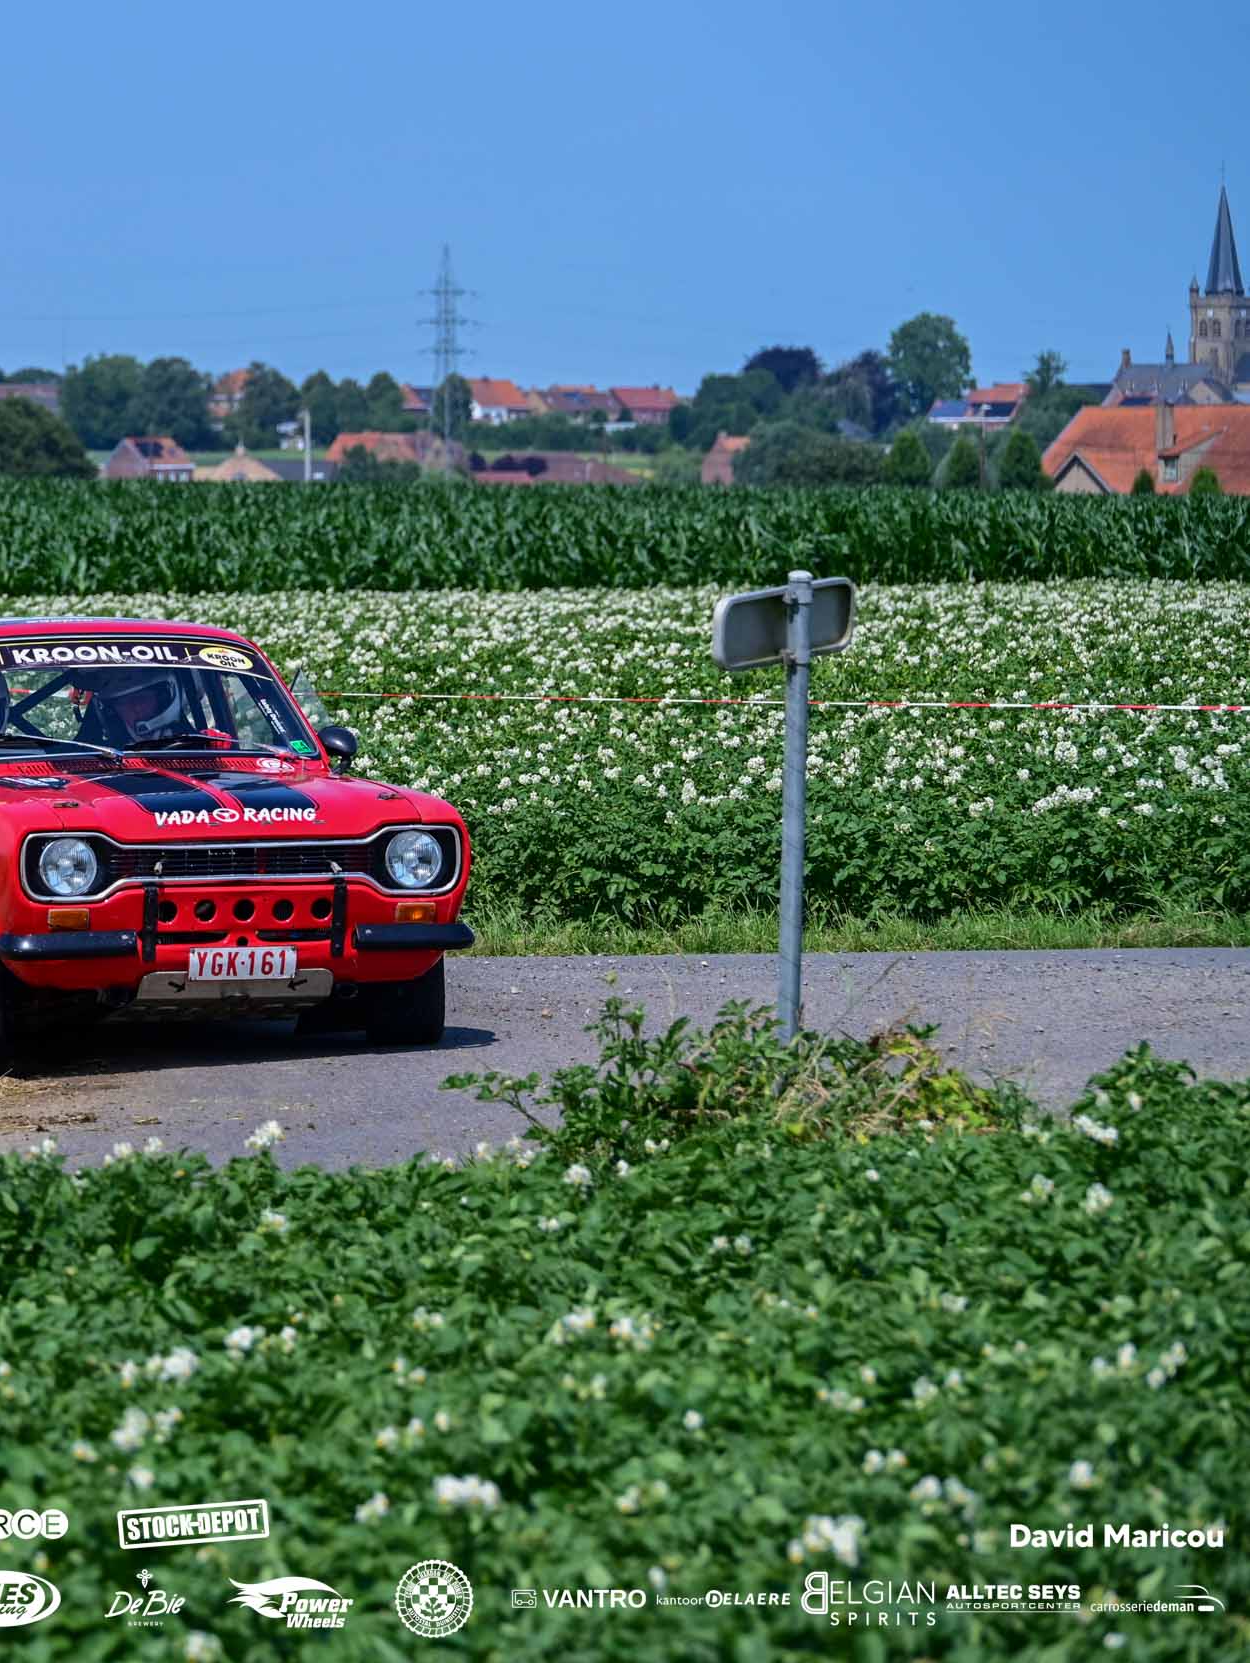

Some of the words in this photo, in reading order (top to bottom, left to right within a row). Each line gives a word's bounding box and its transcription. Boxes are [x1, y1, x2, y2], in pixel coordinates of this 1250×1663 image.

[11, 645, 178, 664] KROON-OIL
[207, 653, 246, 665] KROON
[220, 660, 238, 668] OIL
[154, 810, 209, 827] VADA
[243, 807, 317, 822] RACING
